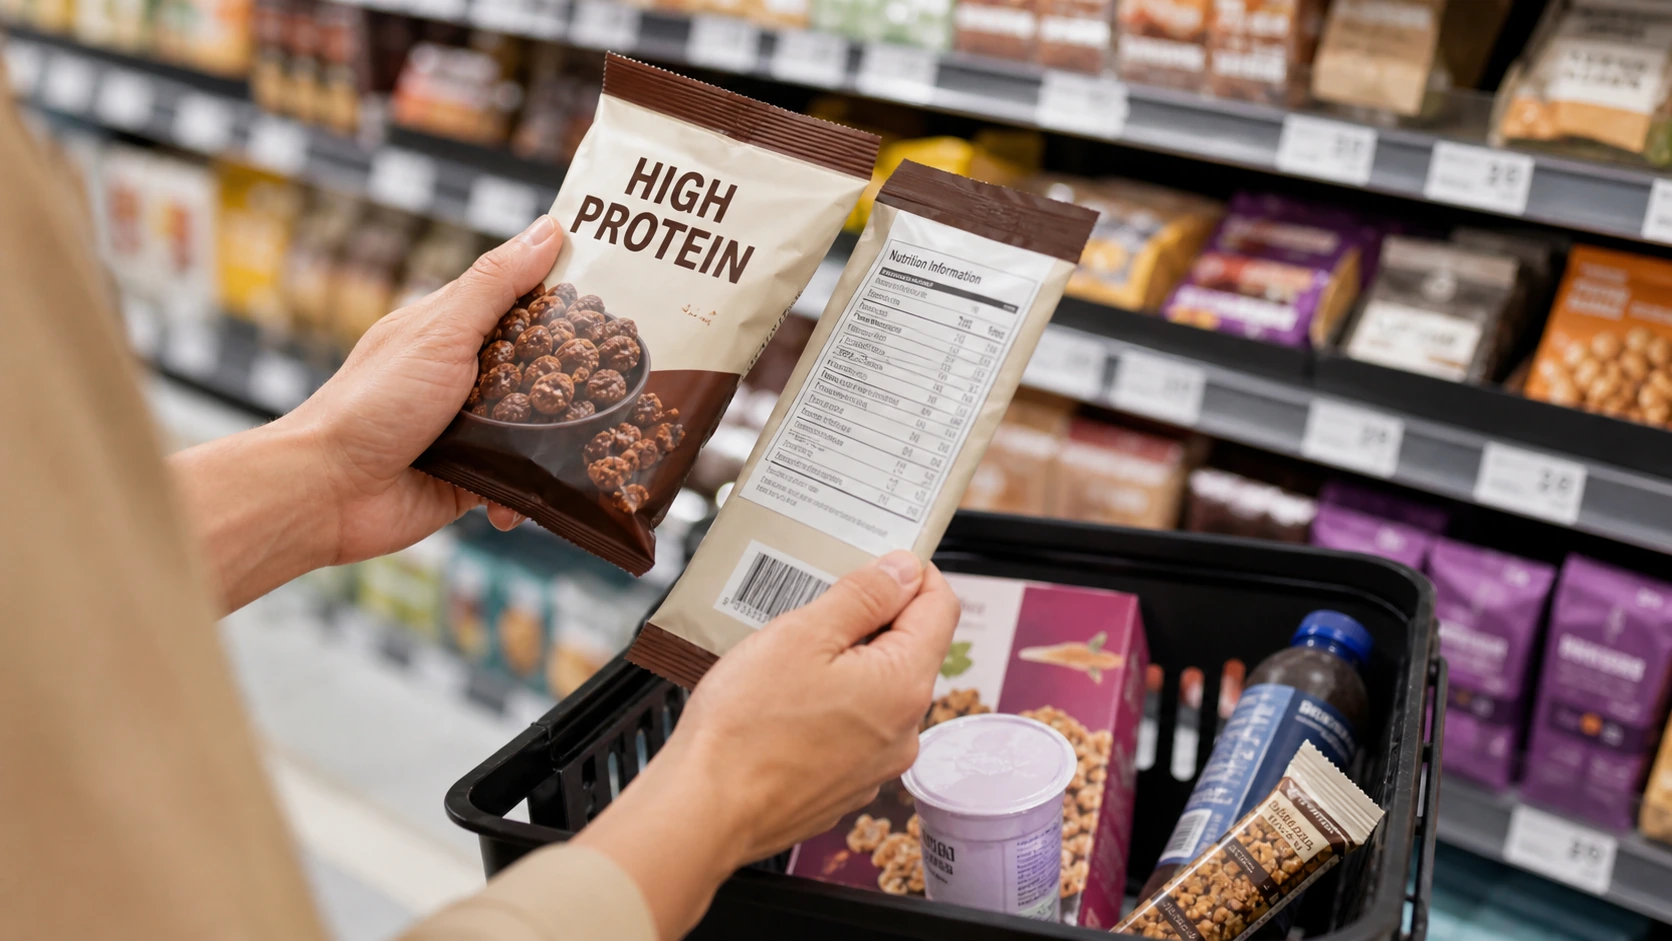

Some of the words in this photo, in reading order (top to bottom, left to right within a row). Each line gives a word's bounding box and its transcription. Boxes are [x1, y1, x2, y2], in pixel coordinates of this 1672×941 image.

[624, 156, 738, 224] HIGH
[569, 194, 755, 285] PROTEIN
[889, 249, 928, 269] Nutrition
[929, 259, 982, 285] Information
